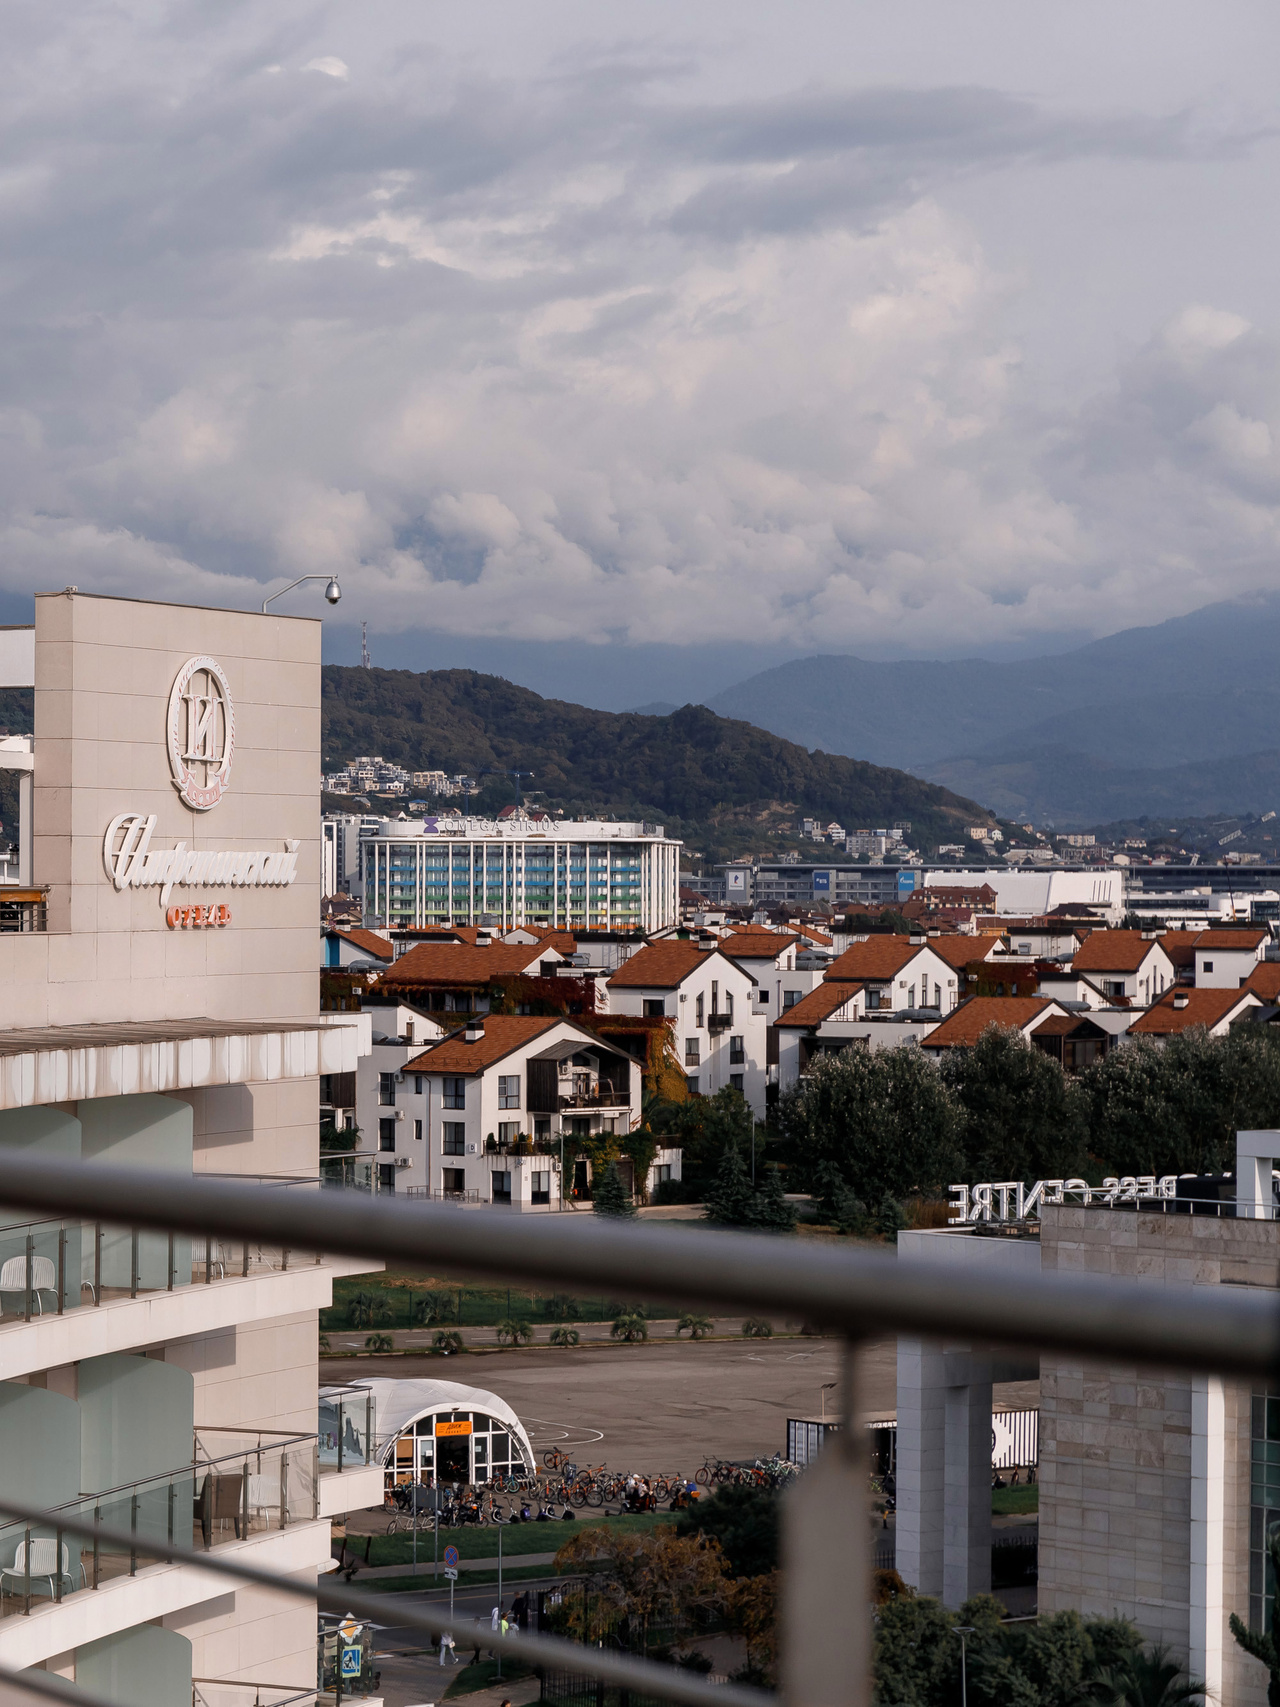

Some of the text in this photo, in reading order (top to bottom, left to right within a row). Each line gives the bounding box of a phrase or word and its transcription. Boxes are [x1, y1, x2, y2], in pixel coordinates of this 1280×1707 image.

[444, 820, 561, 832] OMEGA SIRIUS
[167, 903, 233, 927] ОТЕЛЬ
